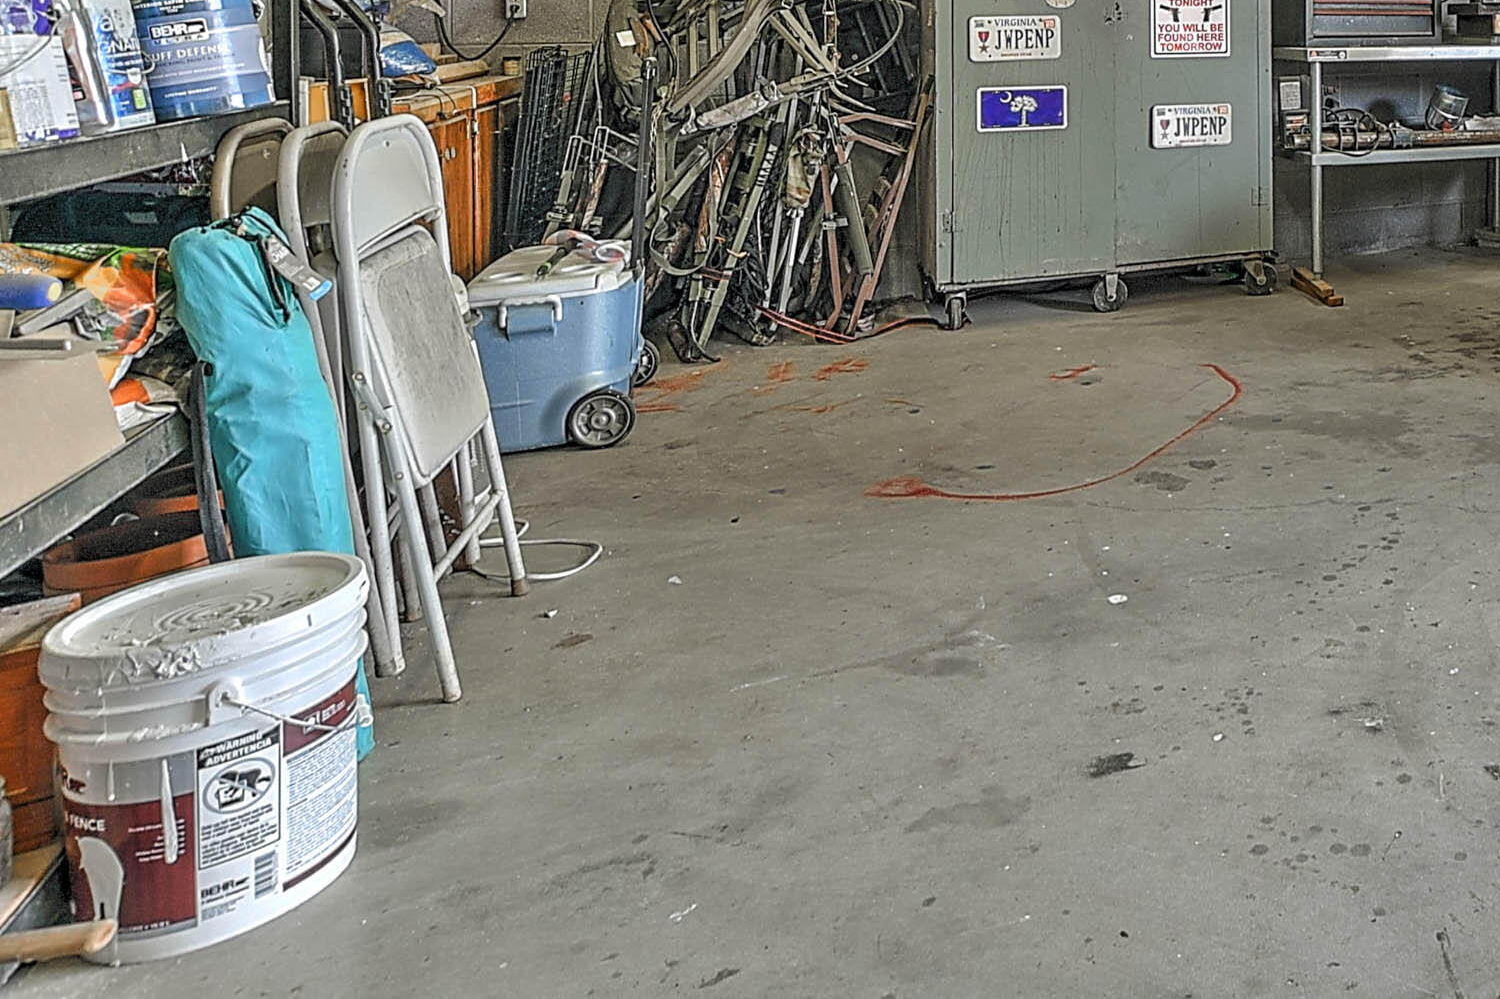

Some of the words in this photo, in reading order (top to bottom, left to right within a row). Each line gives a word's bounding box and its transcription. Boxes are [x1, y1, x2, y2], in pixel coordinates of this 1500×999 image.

[994, 18, 1037, 27] VIRGINIA
[1158, 23, 1180, 33] YOU
[1182, 23, 1208, 32] WILL
[1210, 23, 1224, 32] BE
[150, 23, 188, 39] BEHR
[1158, 33, 1194, 42] FOUND
[1196, 33, 1224, 42] HERE
[994, 28, 1055, 50] JWPENP
[1160, 42, 1222, 52] TOMORROW
[1174, 107, 1211, 115] VIRGINIA
[1174, 115, 1227, 137] JWPENP
[214, 731, 263, 755] WARNING
[205, 736, 273, 768] ADVERTENCIA
